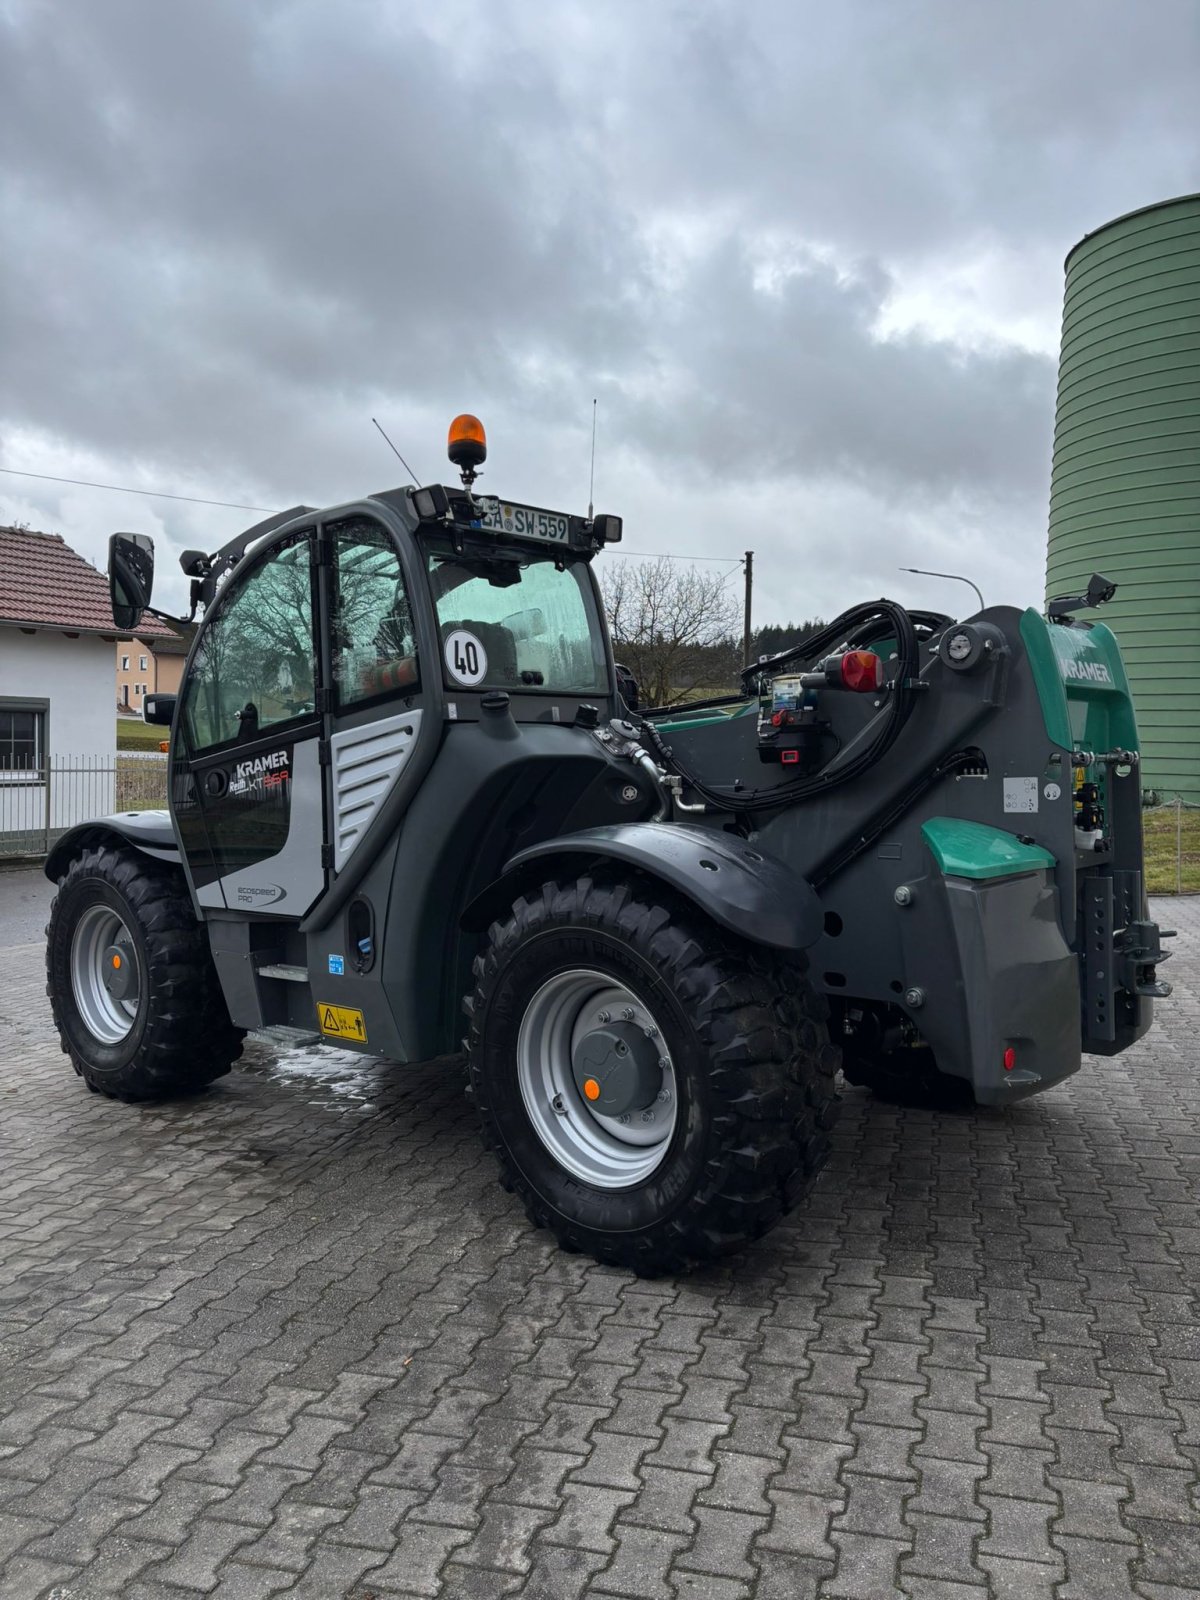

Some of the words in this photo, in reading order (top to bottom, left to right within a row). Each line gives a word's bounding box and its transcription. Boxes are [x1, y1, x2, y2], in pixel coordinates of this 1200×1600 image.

[514, 510, 536, 535] SW
[539, 515, 567, 540] 559
[454, 640, 479, 675] 40
[1059, 659, 1111, 682] KRAMER
[236, 751, 289, 778] KRAMER
